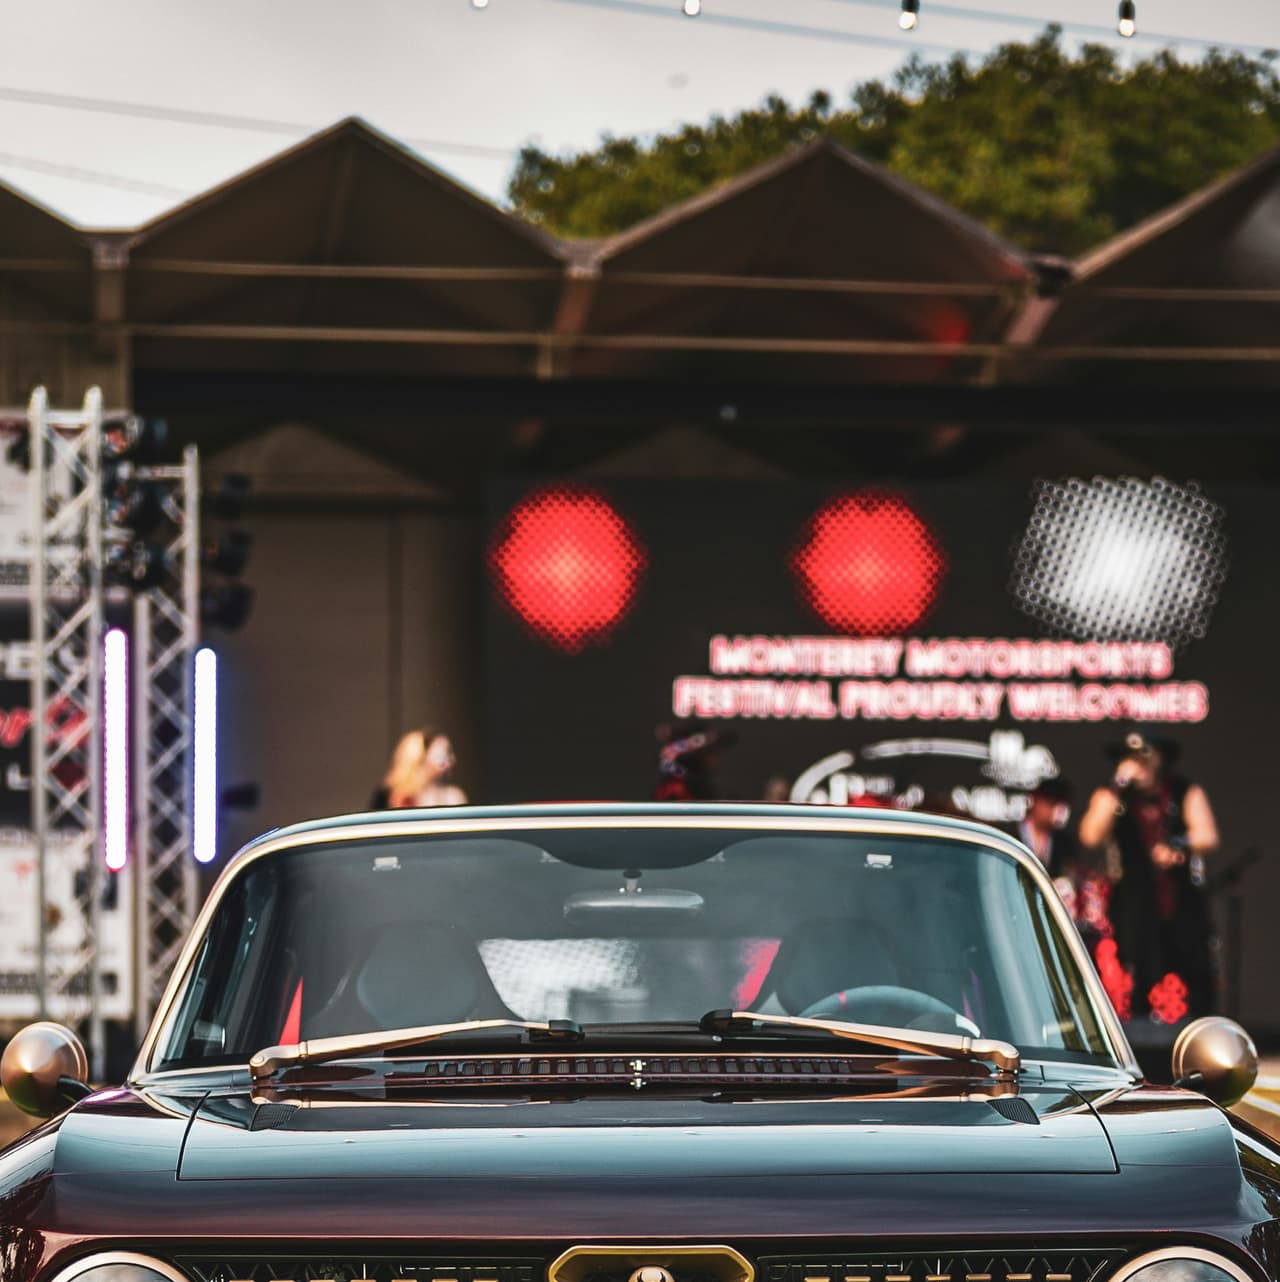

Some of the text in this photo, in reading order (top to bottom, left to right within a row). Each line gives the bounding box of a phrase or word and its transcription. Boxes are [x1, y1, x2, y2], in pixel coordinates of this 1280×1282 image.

[709, 635, 1173, 678] MONTEREY MOTORSPORTS
[673, 676, 1209, 723] FESTIVAL PROUDLY WELCOMES
